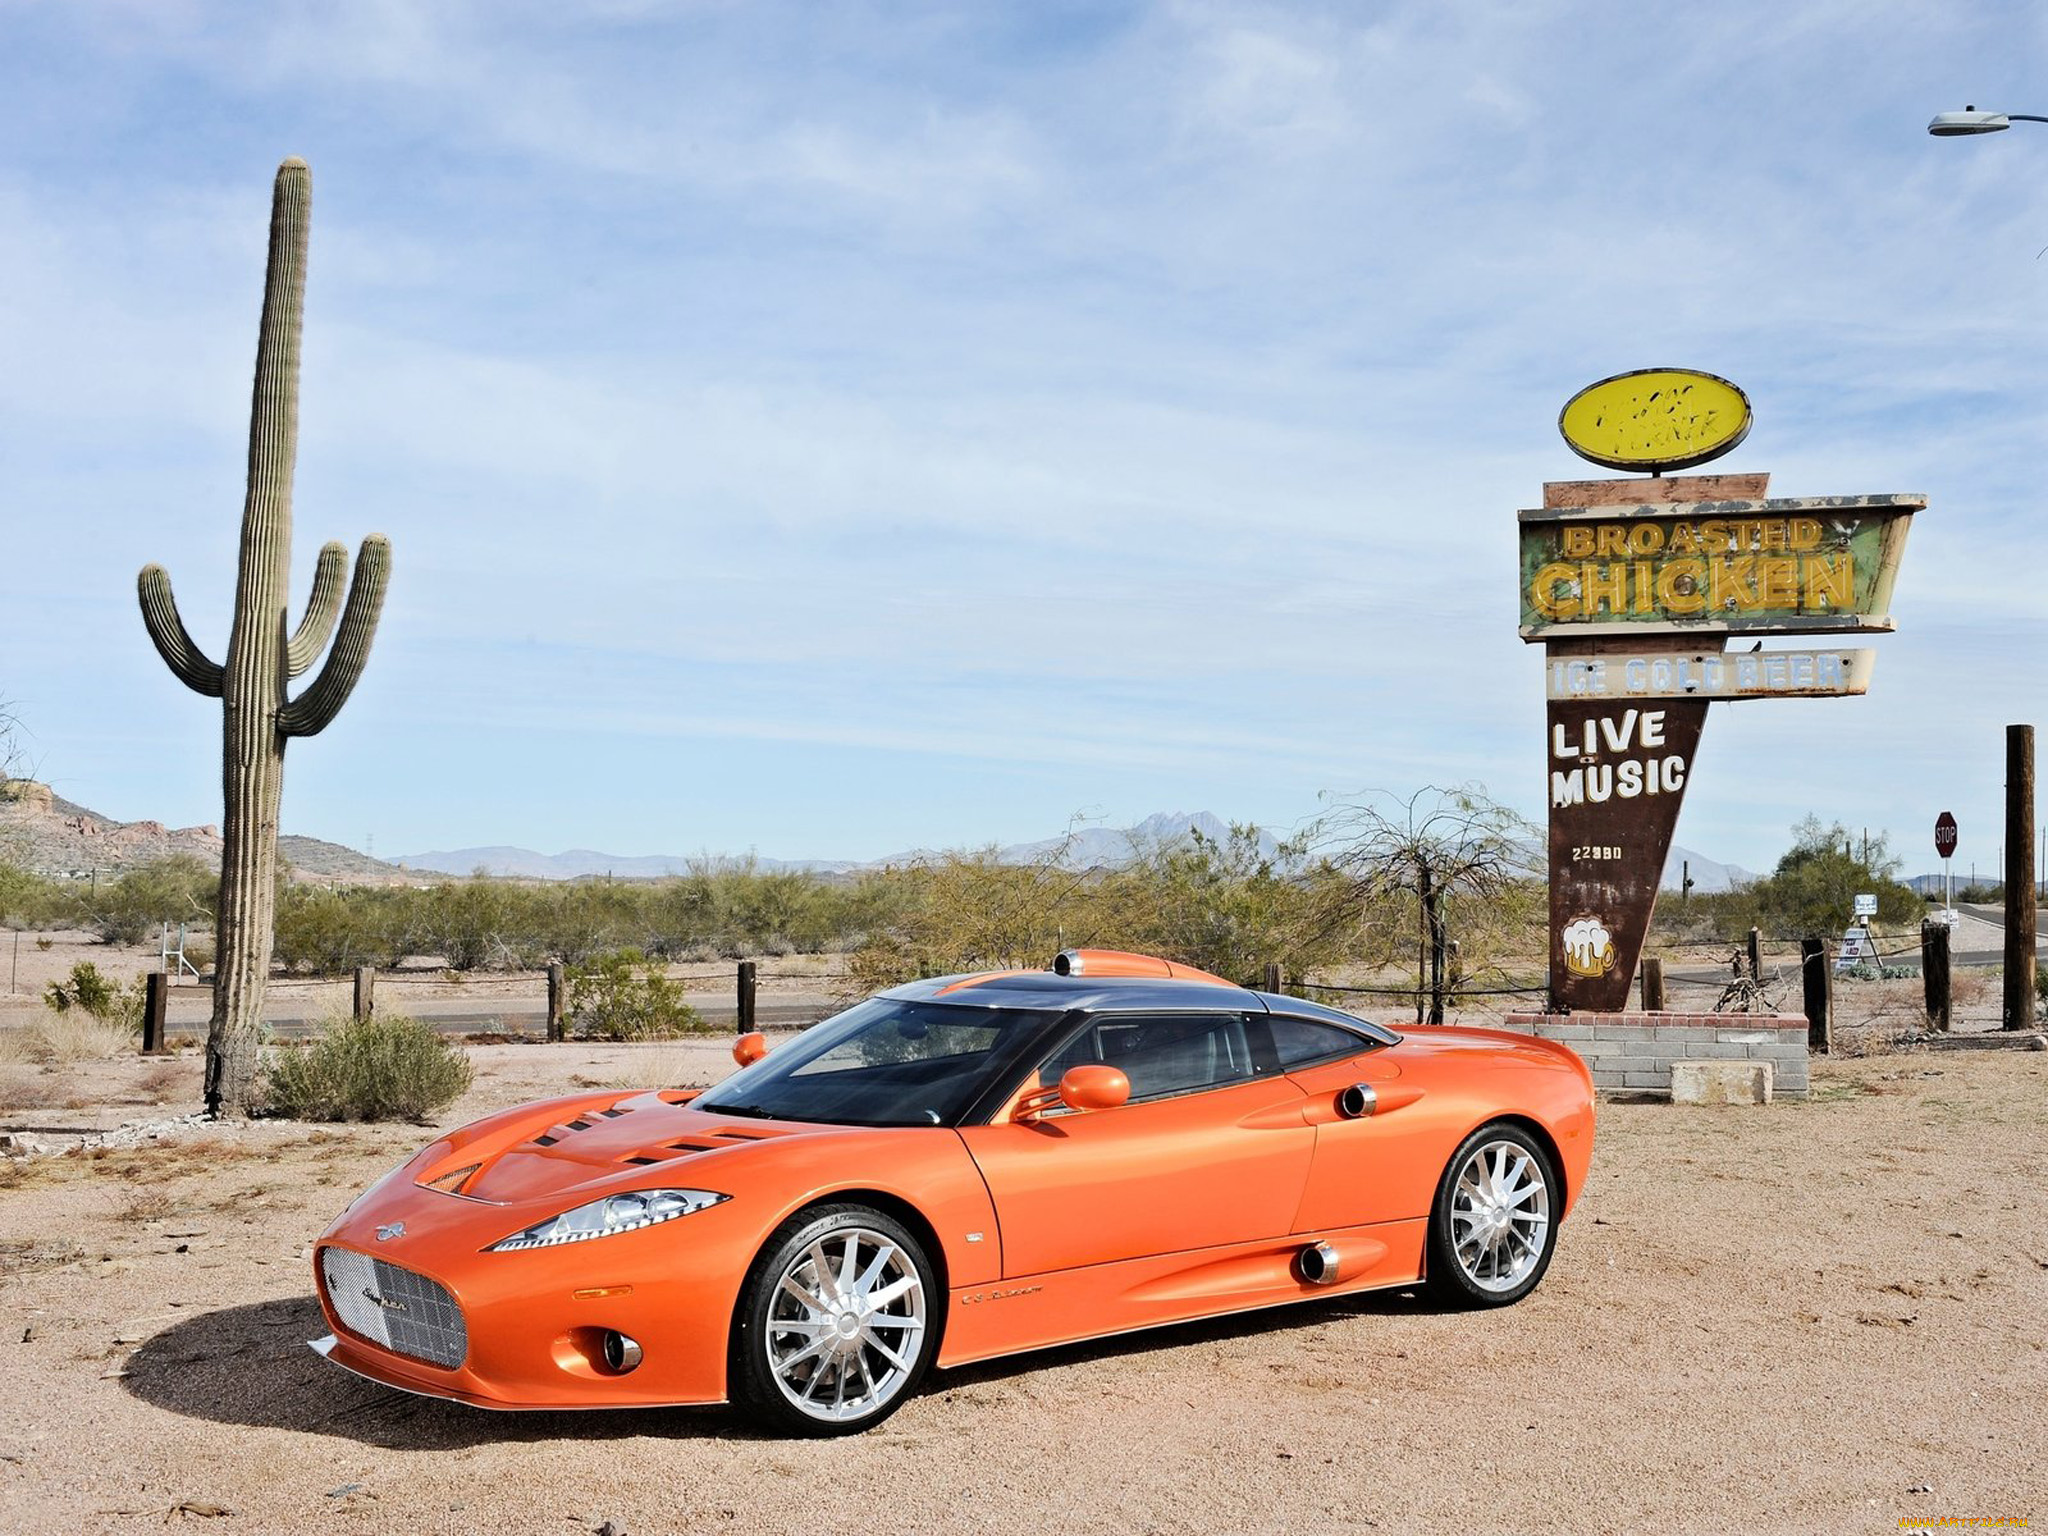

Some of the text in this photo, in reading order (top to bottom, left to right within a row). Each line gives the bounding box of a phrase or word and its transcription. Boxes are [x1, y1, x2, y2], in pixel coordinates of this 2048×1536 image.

[1562, 517, 1823, 558] BROASTED
[1531, 553, 1855, 617] CHICKEN
[1554, 653, 1842, 694] ICE COLD BEER
[1553, 709, 1666, 759] LIVE
[1552, 755, 1685, 808] MUSIC
[1936, 826, 1956, 844] STOP
